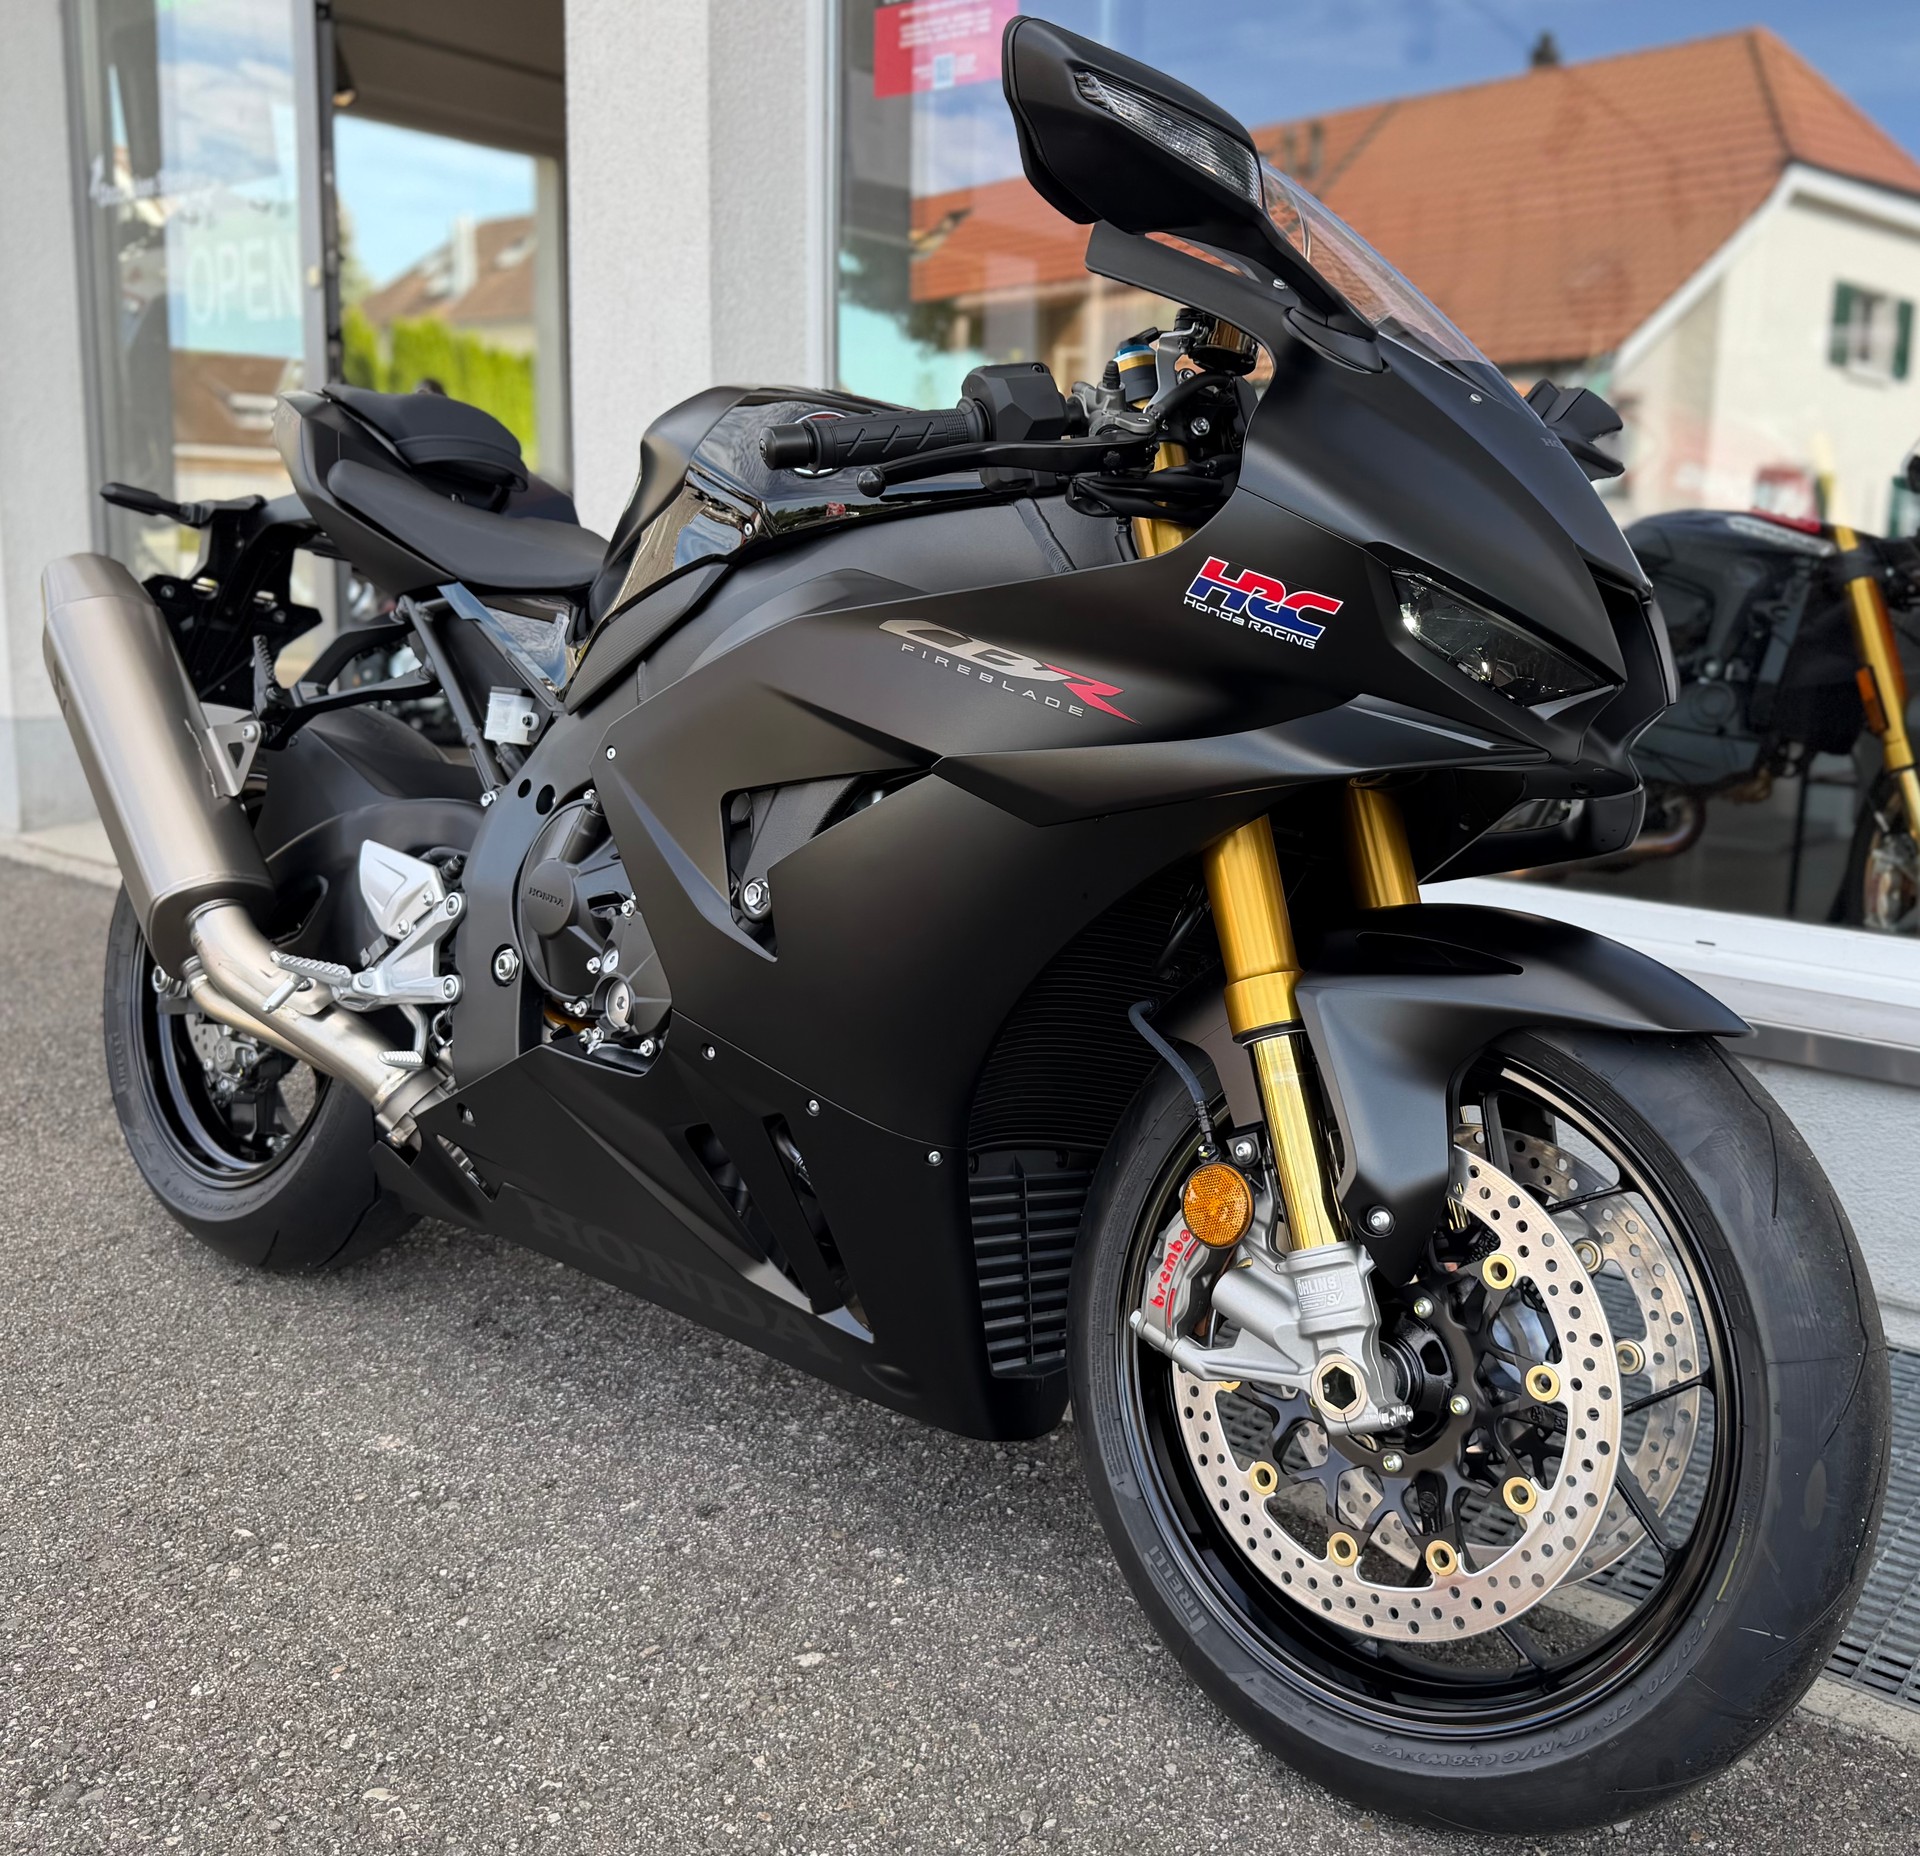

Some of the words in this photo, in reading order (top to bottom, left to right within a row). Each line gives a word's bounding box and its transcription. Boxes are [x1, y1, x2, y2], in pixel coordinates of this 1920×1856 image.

[186, 236, 302, 324] OPEN
[1183, 596, 1246, 627] Honda
[1247, 620, 1318, 650] RACING
[1185, 555, 1345, 641] HRC
[878, 618, 1143, 726] CBR
[900, 642, 1084, 718] FIREBLADE
[528, 886, 565, 908] HONDA
[516, 1191, 844, 1365] HONDA
[1149, 1228, 1192, 1310] brembo
[1143, 1545, 1209, 1635] PIRELLI
